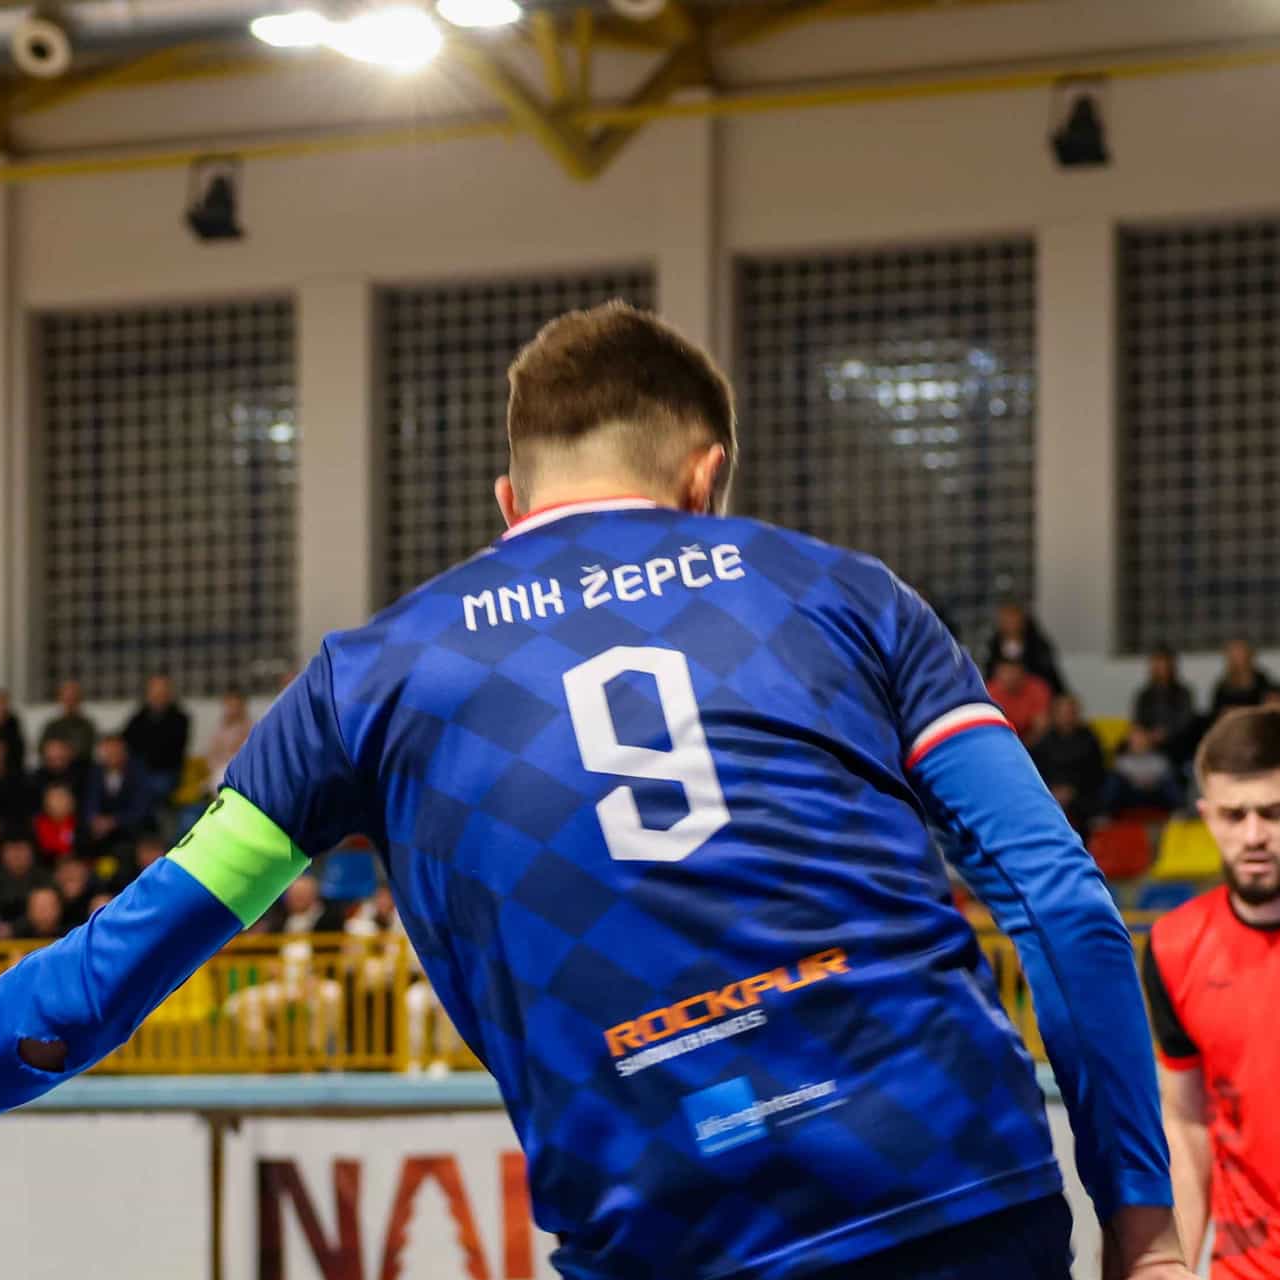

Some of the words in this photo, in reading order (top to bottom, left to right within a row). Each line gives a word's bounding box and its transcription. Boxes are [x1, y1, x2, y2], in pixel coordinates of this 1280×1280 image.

[462, 578, 565, 631] MNK
[580, 544, 746, 609] ŽEPČE
[562, 646, 732, 862] 9
[604, 947, 851, 1057] ROCKPUR
